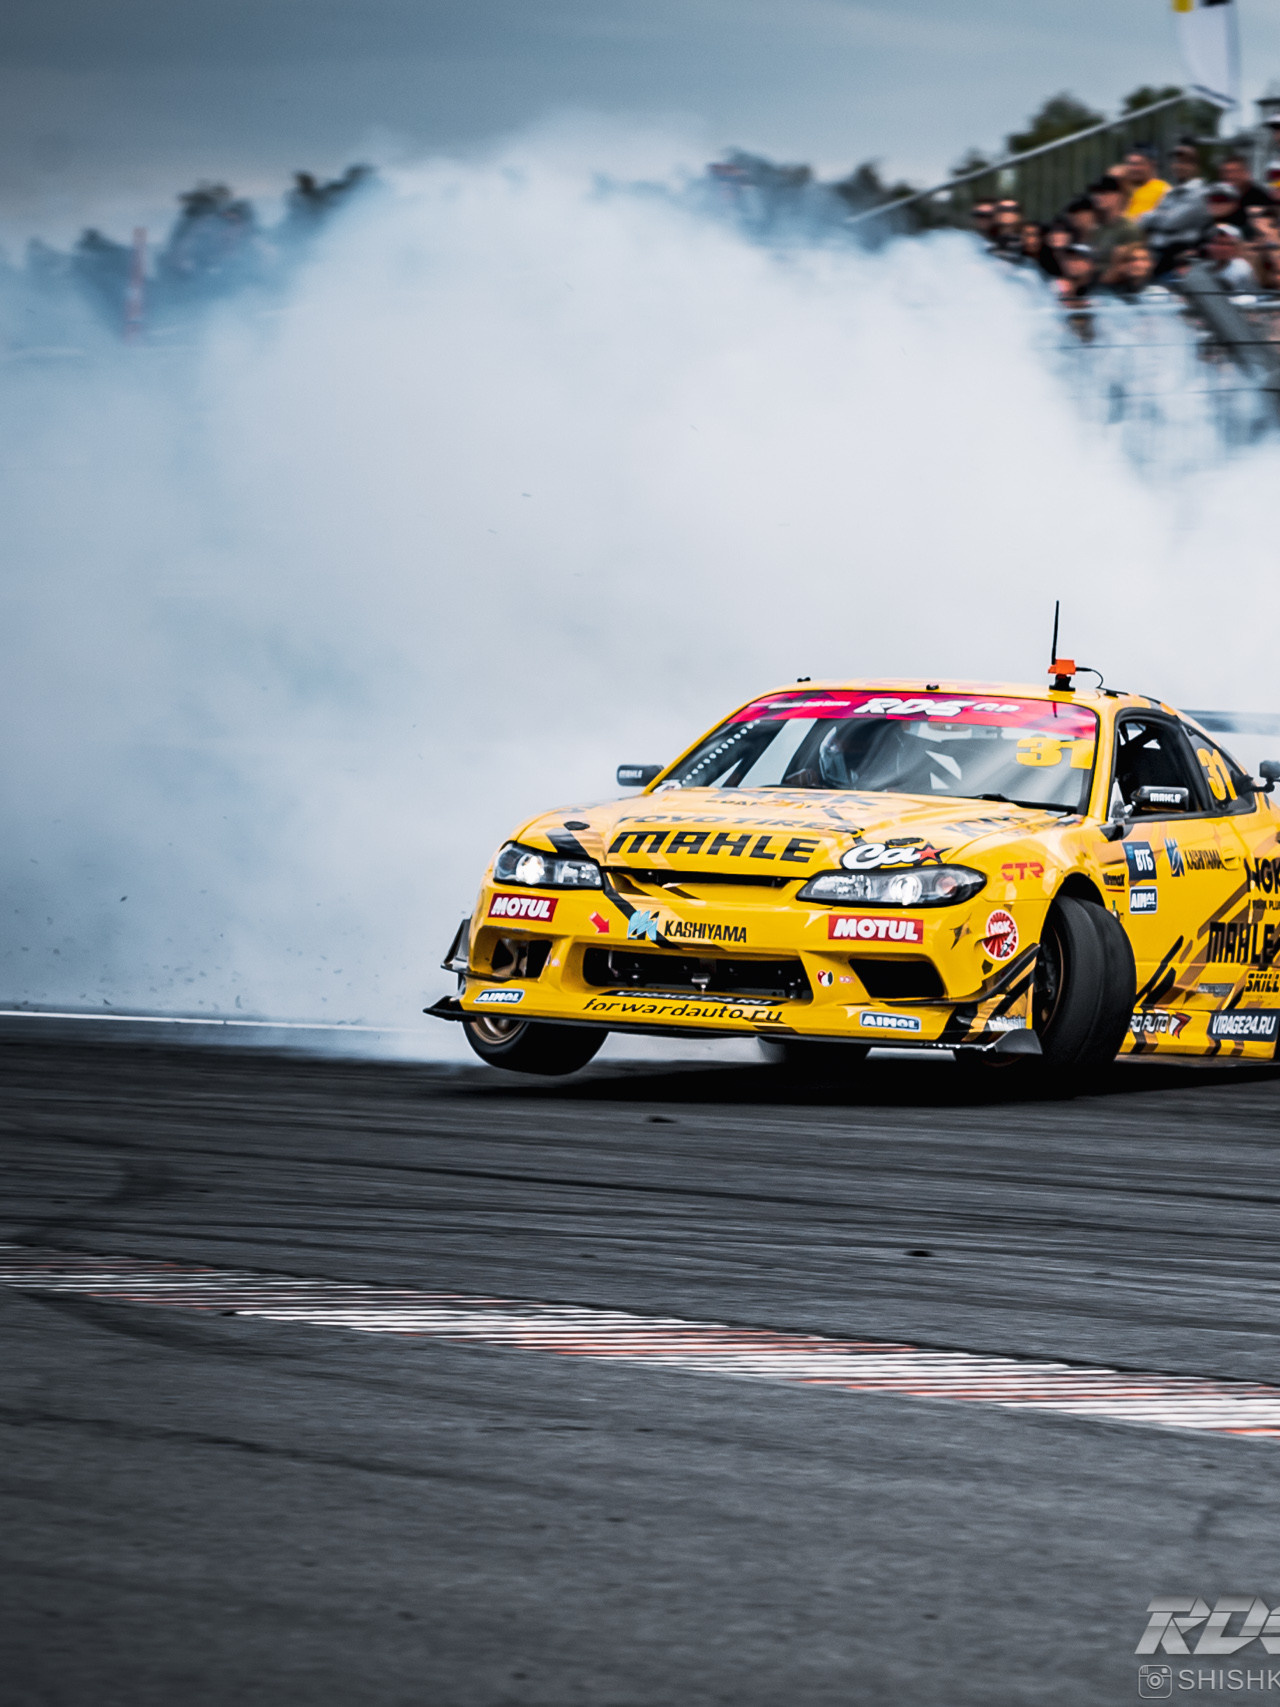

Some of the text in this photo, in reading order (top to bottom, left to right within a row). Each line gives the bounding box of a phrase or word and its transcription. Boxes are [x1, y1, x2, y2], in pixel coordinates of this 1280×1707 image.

[853, 697, 974, 717] RDS
[1016, 737, 1096, 770] 31
[1196, 747, 1239, 801] 31
[607, 830, 821, 863] MAHLE
[1001, 861, 1045, 881] CTR
[1134, 849, 1154, 872] ВТБ
[489, 896, 551, 919] MOTUL
[664, 919, 747, 944] KASHIYAMA
[833, 917, 919, 941] MOTUL
[1206, 921, 1276, 964] MAHLE
[1244, 973, 1280, 993] SKILL
[1211, 1014, 1277, 1035] VIRAGE24.RU
